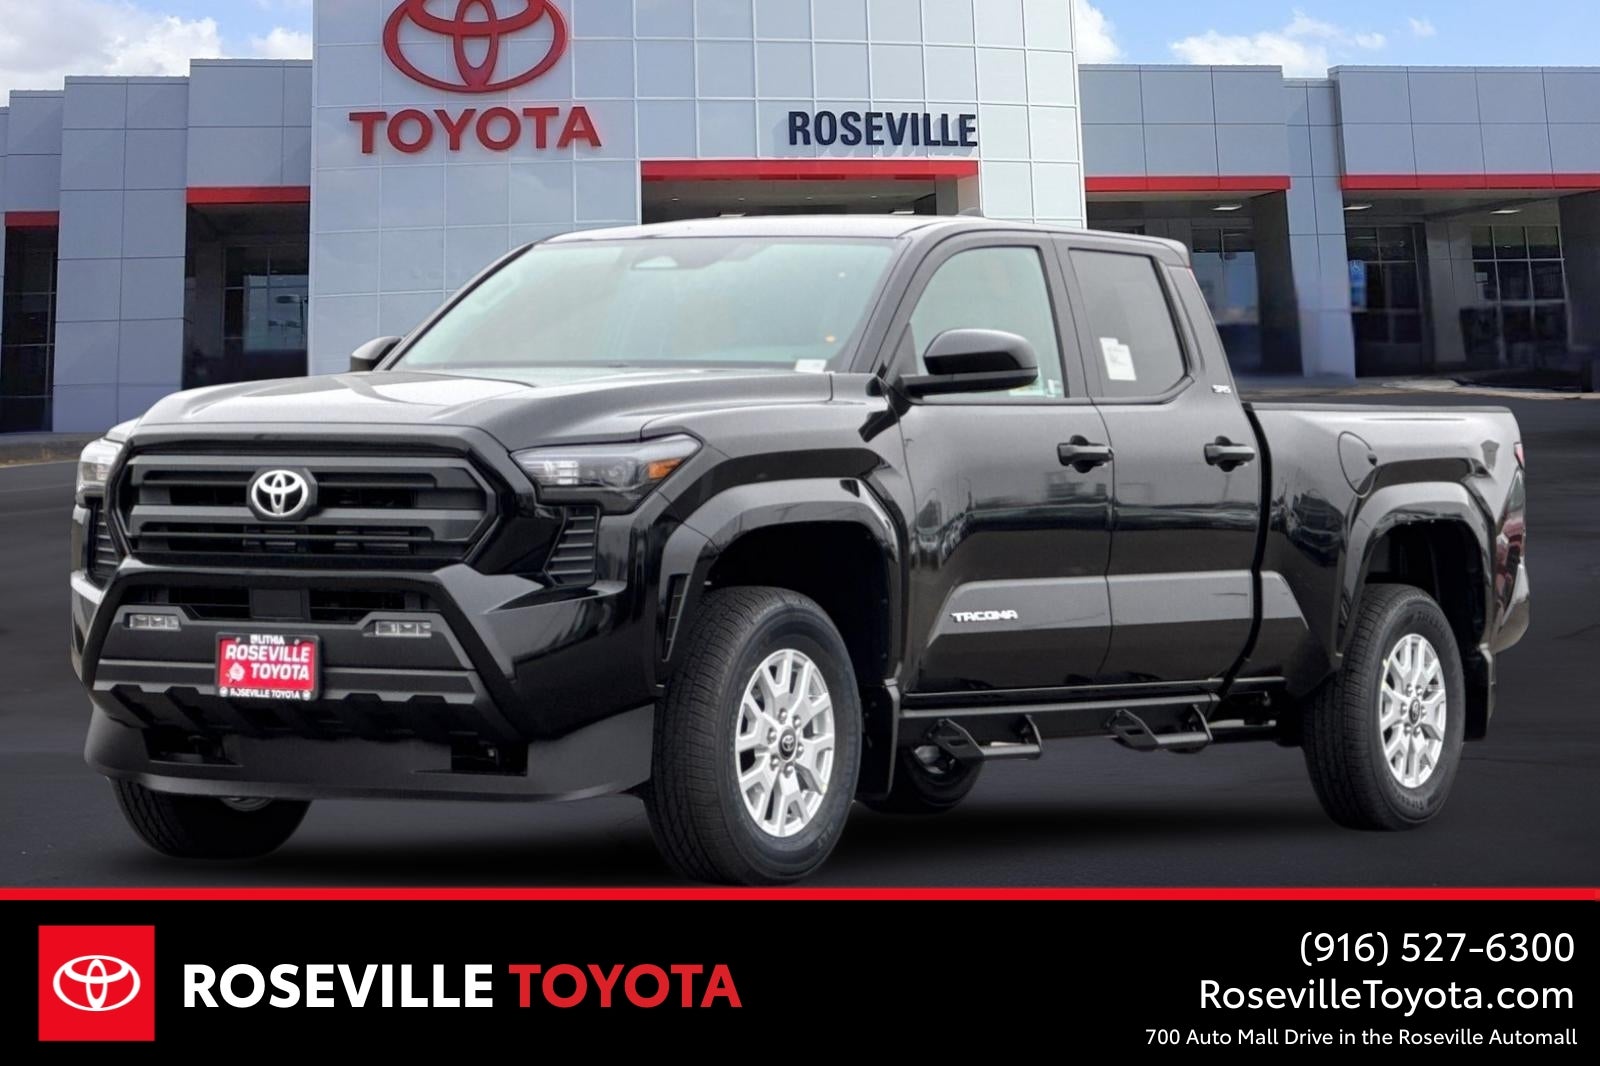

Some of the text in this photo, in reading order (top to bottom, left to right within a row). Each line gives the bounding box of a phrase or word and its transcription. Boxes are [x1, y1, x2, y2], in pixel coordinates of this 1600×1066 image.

[349, 106, 602, 154] TOYOTA
[788, 110, 979, 148] ROSEVILLE
[951, 609, 1018, 622] TACOMA
[225, 644, 311, 662] ROSEVILLE
[250, 663, 309, 680] TOYOTA
